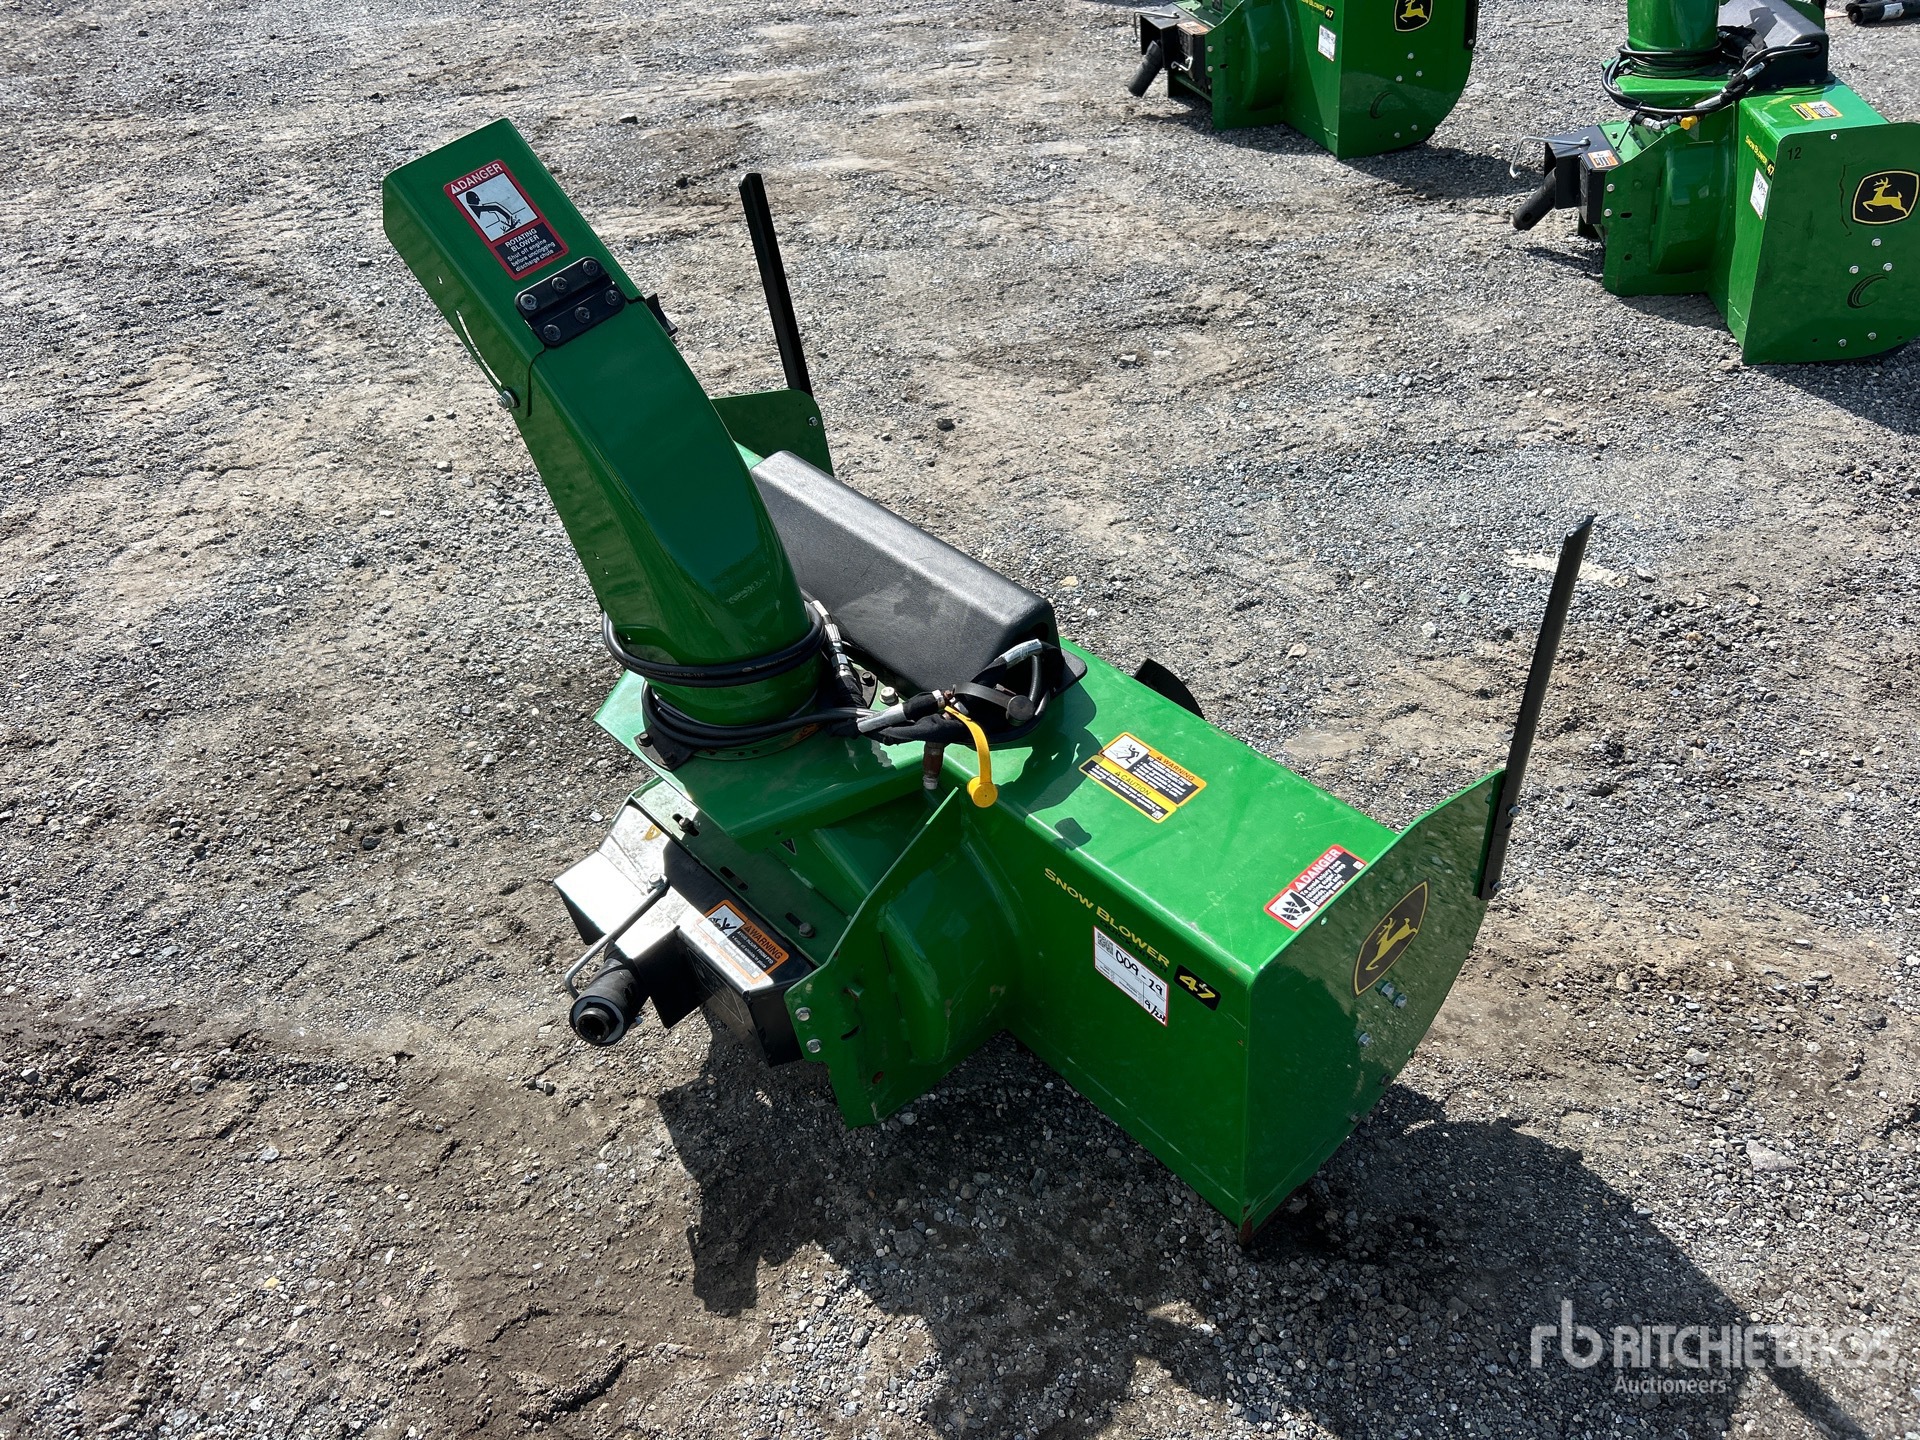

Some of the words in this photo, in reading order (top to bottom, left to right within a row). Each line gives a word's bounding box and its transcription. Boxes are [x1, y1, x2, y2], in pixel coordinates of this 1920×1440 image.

[1326, 9, 1334, 18] 47
[1745, 135, 1755, 151] SNOW
[1754, 144, 1768, 164] BLOWER
[1766, 164, 1775, 176] 47
[1787, 147, 1802, 160] 12
[458, 163, 503, 190] DANGER
[505, 228, 537, 248] ROTATING
[510, 234, 540, 252] BLOWER
[507, 252, 521, 261] Shut
[529, 239, 547, 250] engine
[511, 256, 528, 266] before
[528, 242, 556, 258] unclogging
[516, 258, 540, 272] discharge
[540, 249, 554, 259] chute
[1162, 759, 1195, 781] WARNING
[1119, 774, 1151, 796] CAUTION
[1300, 849, 1342, 887] DANGER
[750, 929, 783, 960] WARNING
[1044, 868, 1094, 909] SNOW
[1096, 906, 1170, 967] BLOWER
[1178, 974, 1216, 999] 47
